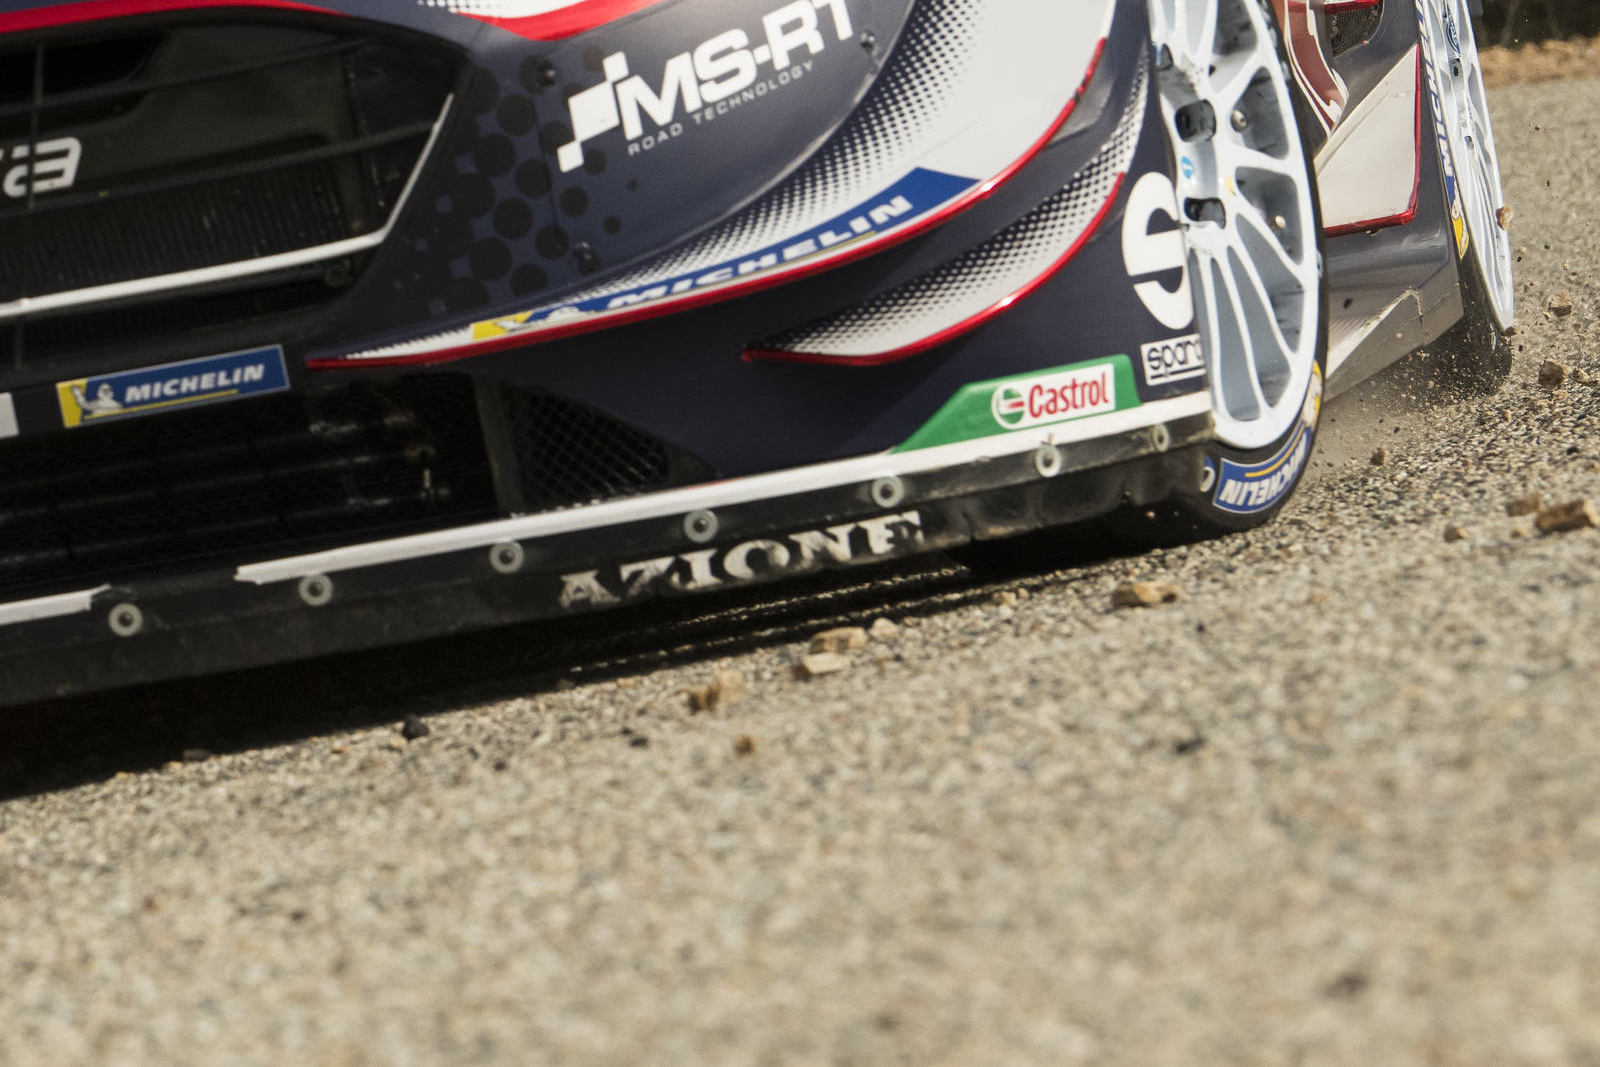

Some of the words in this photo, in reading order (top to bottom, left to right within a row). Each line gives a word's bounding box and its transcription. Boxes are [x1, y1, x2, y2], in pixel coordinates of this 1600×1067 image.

[627, 123, 684, 156] ROAD
[690, 59, 815, 125] TECHNOLOGY
[606, 195, 913, 309] MICHELIN
[125, 363, 264, 403] MICHELIN
[1029, 372, 1109, 418] Castrol
